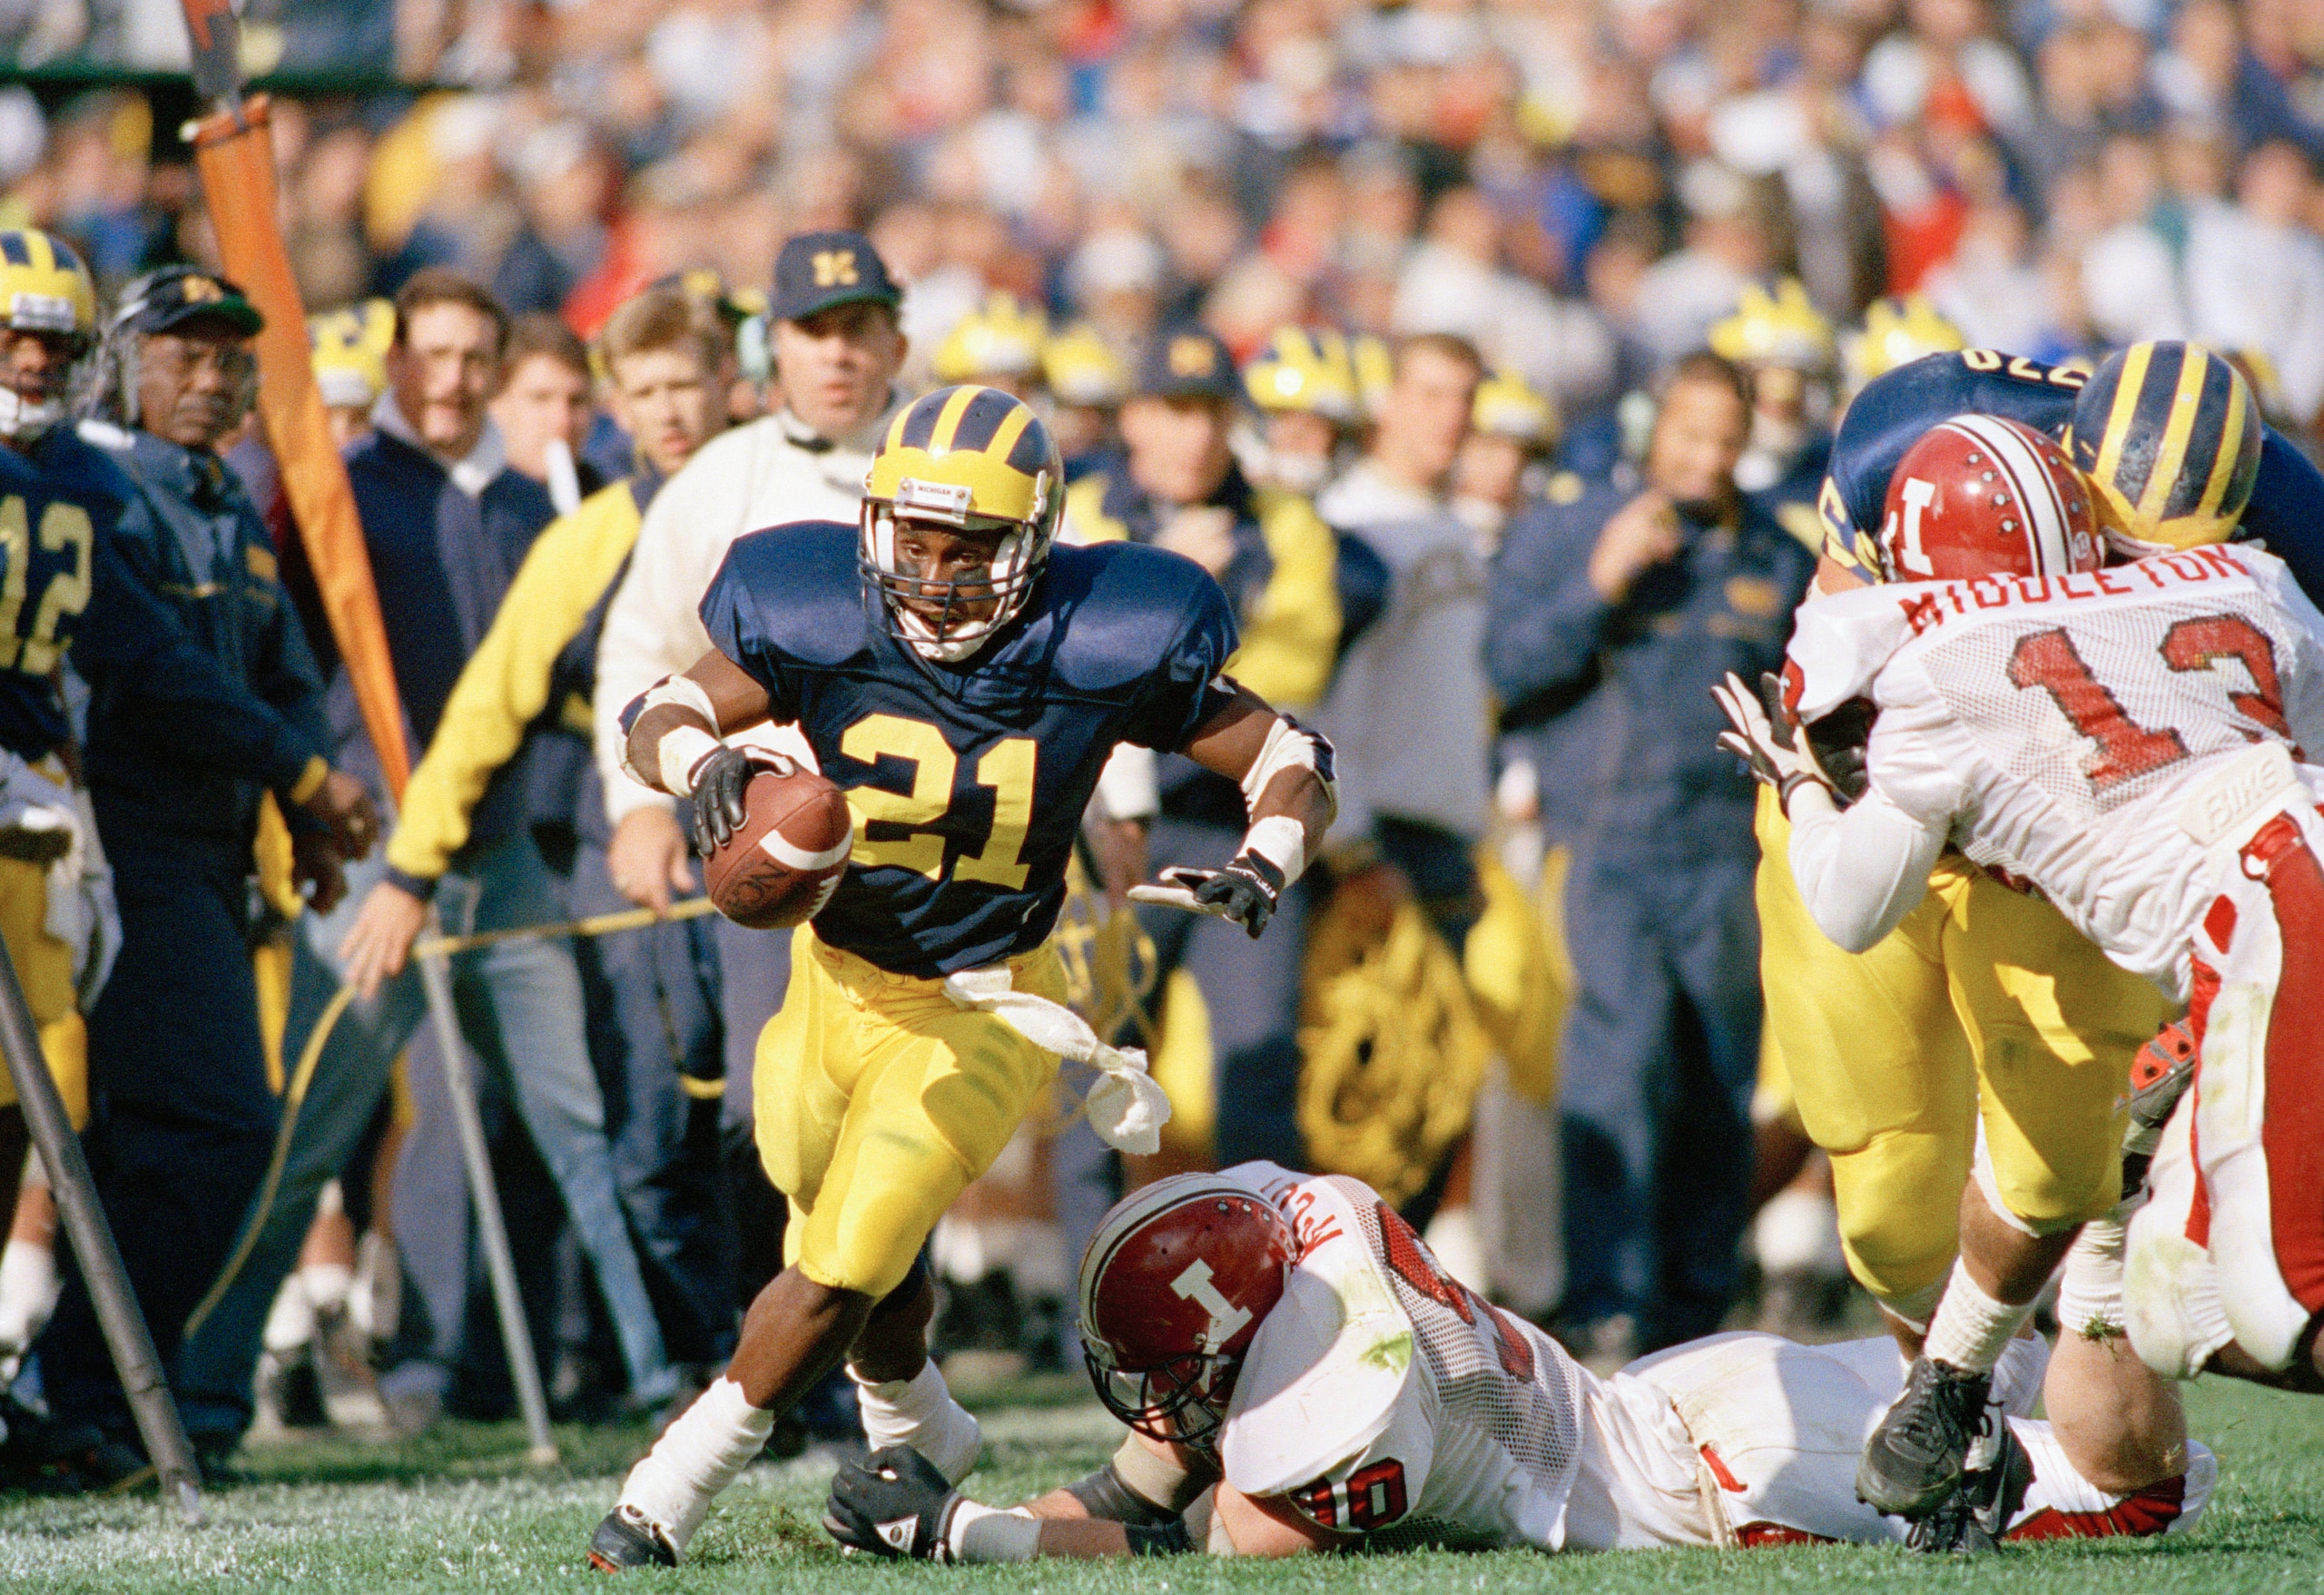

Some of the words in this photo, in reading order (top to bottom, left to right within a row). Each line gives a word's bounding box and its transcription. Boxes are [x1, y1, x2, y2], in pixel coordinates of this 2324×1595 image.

[918, 485, 951, 496] MICHIGAN
[1898, 545, 2251, 635] MIDDLETON
[2006, 613, 2306, 797] 13
[841, 713, 1038, 891] 21
